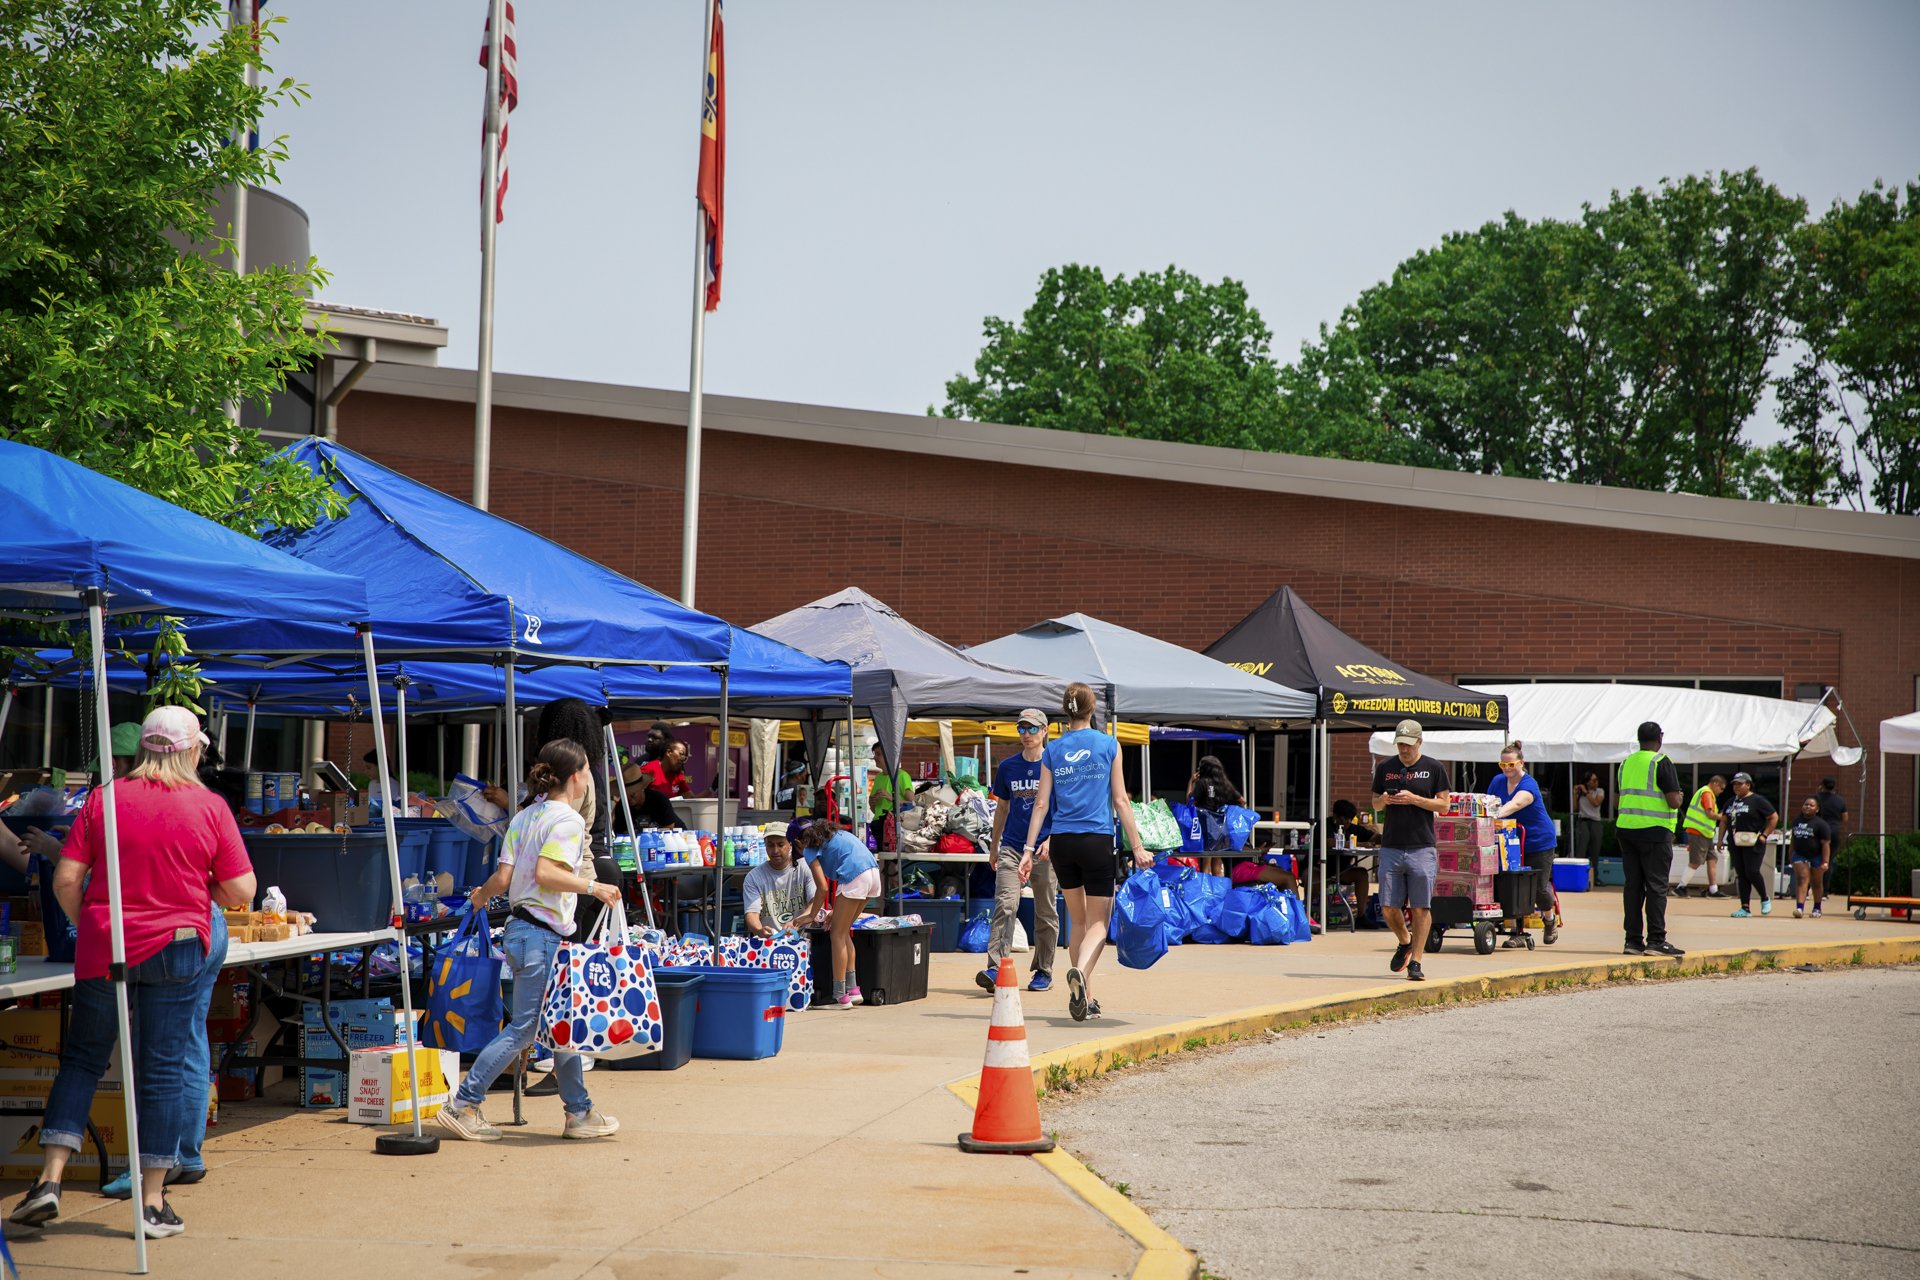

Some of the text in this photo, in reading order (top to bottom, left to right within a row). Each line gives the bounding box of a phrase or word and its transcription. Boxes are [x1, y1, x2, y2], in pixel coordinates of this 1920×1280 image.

[1335, 664, 1407, 682] ACTION
[1351, 698, 1481, 718] FREEDOM REQUIRES ACTION
[1011, 780, 1040, 791] BLUE
[1056, 775, 1079, 785] Physical
[773, 952, 795, 961] save
[777, 959, 795, 970] lot
[350, 1033, 385, 1042] FREEZER
[367, 1097, 385, 1106] CHEESE
[444, 1103, 460, 1121] HOKA
